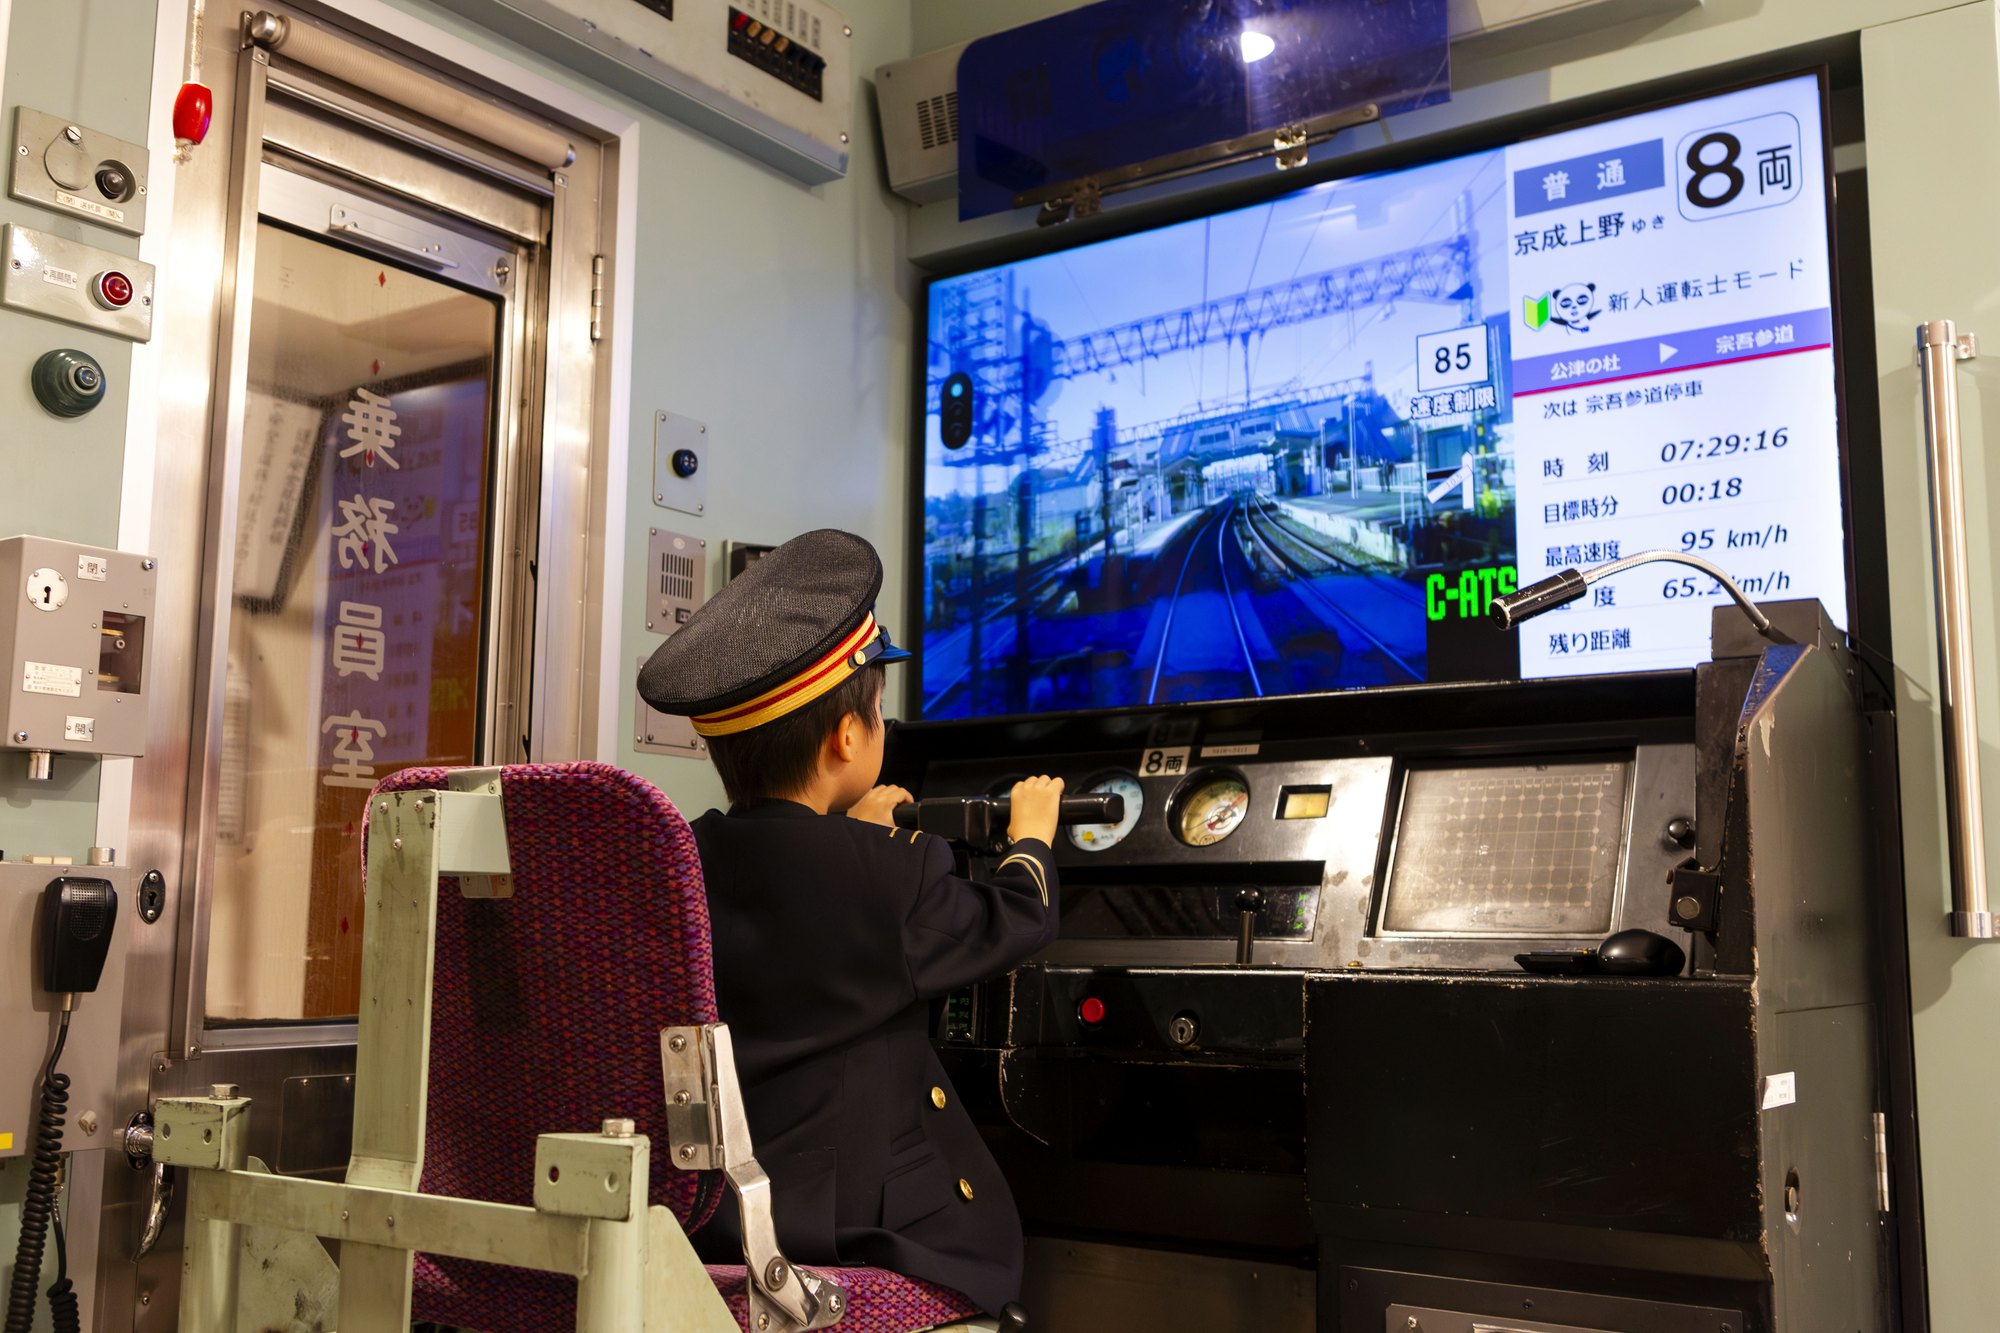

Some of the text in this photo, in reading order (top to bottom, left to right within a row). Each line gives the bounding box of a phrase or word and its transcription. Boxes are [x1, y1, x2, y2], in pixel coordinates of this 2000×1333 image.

[1542, 159, 1626, 201] 普通
[1686, 132, 1792, 208] 8両
[1608, 258, 1805, 314] 新人運転士モード
[1434, 343, 1473, 374] 85
[1550, 324, 1796, 382] 公津の杜 宗吾参道
[1410, 385, 1496, 420] 速度制限
[1543, 380, 1704, 420] 次は 宗吾参道停車
[1661, 427, 1788, 463] 07:29:16
[1543, 451, 1610, 478] 時刻
[1662, 477, 1742, 505] 00:18
[1544, 495, 1619, 524] 目標時分
[1545, 540, 1621, 567] 最高速度
[1681, 524, 1788, 551] 95 km/h
[1426, 565, 1518, 621] C-ATS
[1548, 627, 1632, 655] 残り距離
[1145, 750, 1185, 774] 8両
